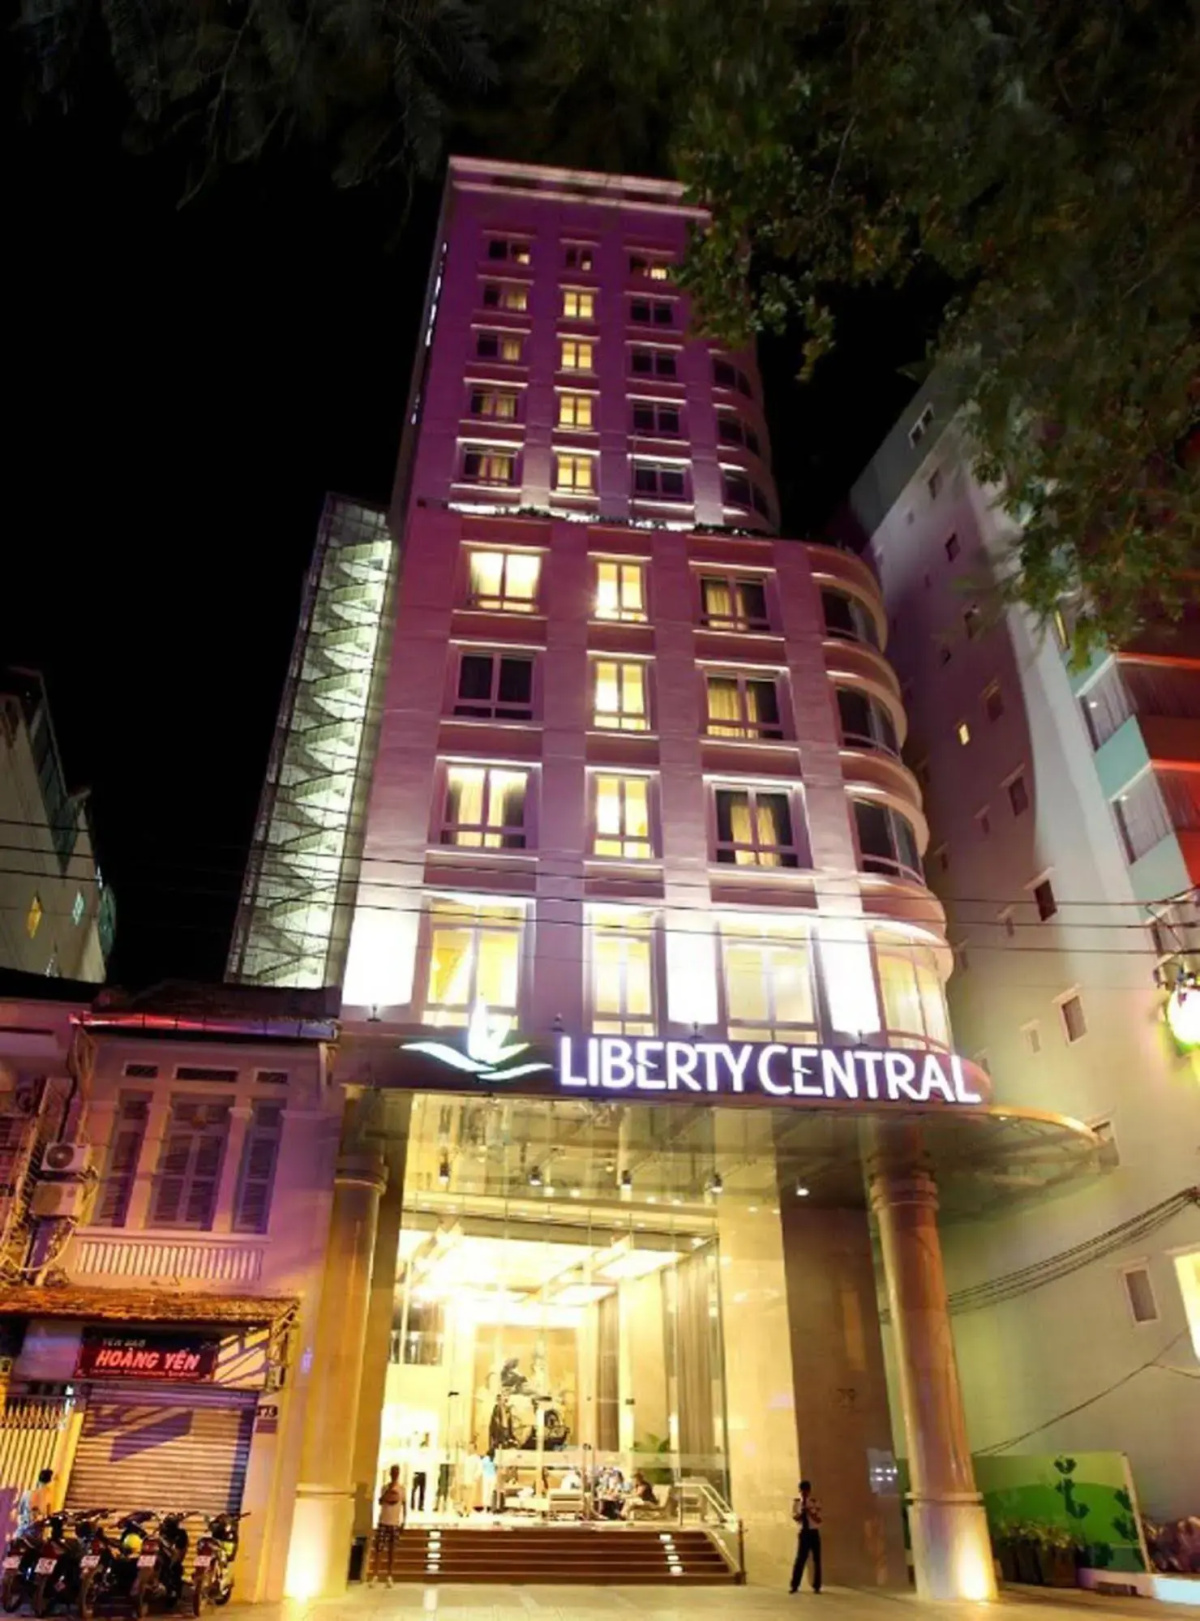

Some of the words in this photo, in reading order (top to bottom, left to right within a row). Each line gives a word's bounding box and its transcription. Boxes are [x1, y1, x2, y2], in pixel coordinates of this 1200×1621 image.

[560, 1036, 754, 1092] LIBERTY
[757, 1044, 982, 1103] CENTRAL
[95, 1347, 160, 1369] HOÀNG
[164, 1347, 201, 1371] YẾN
